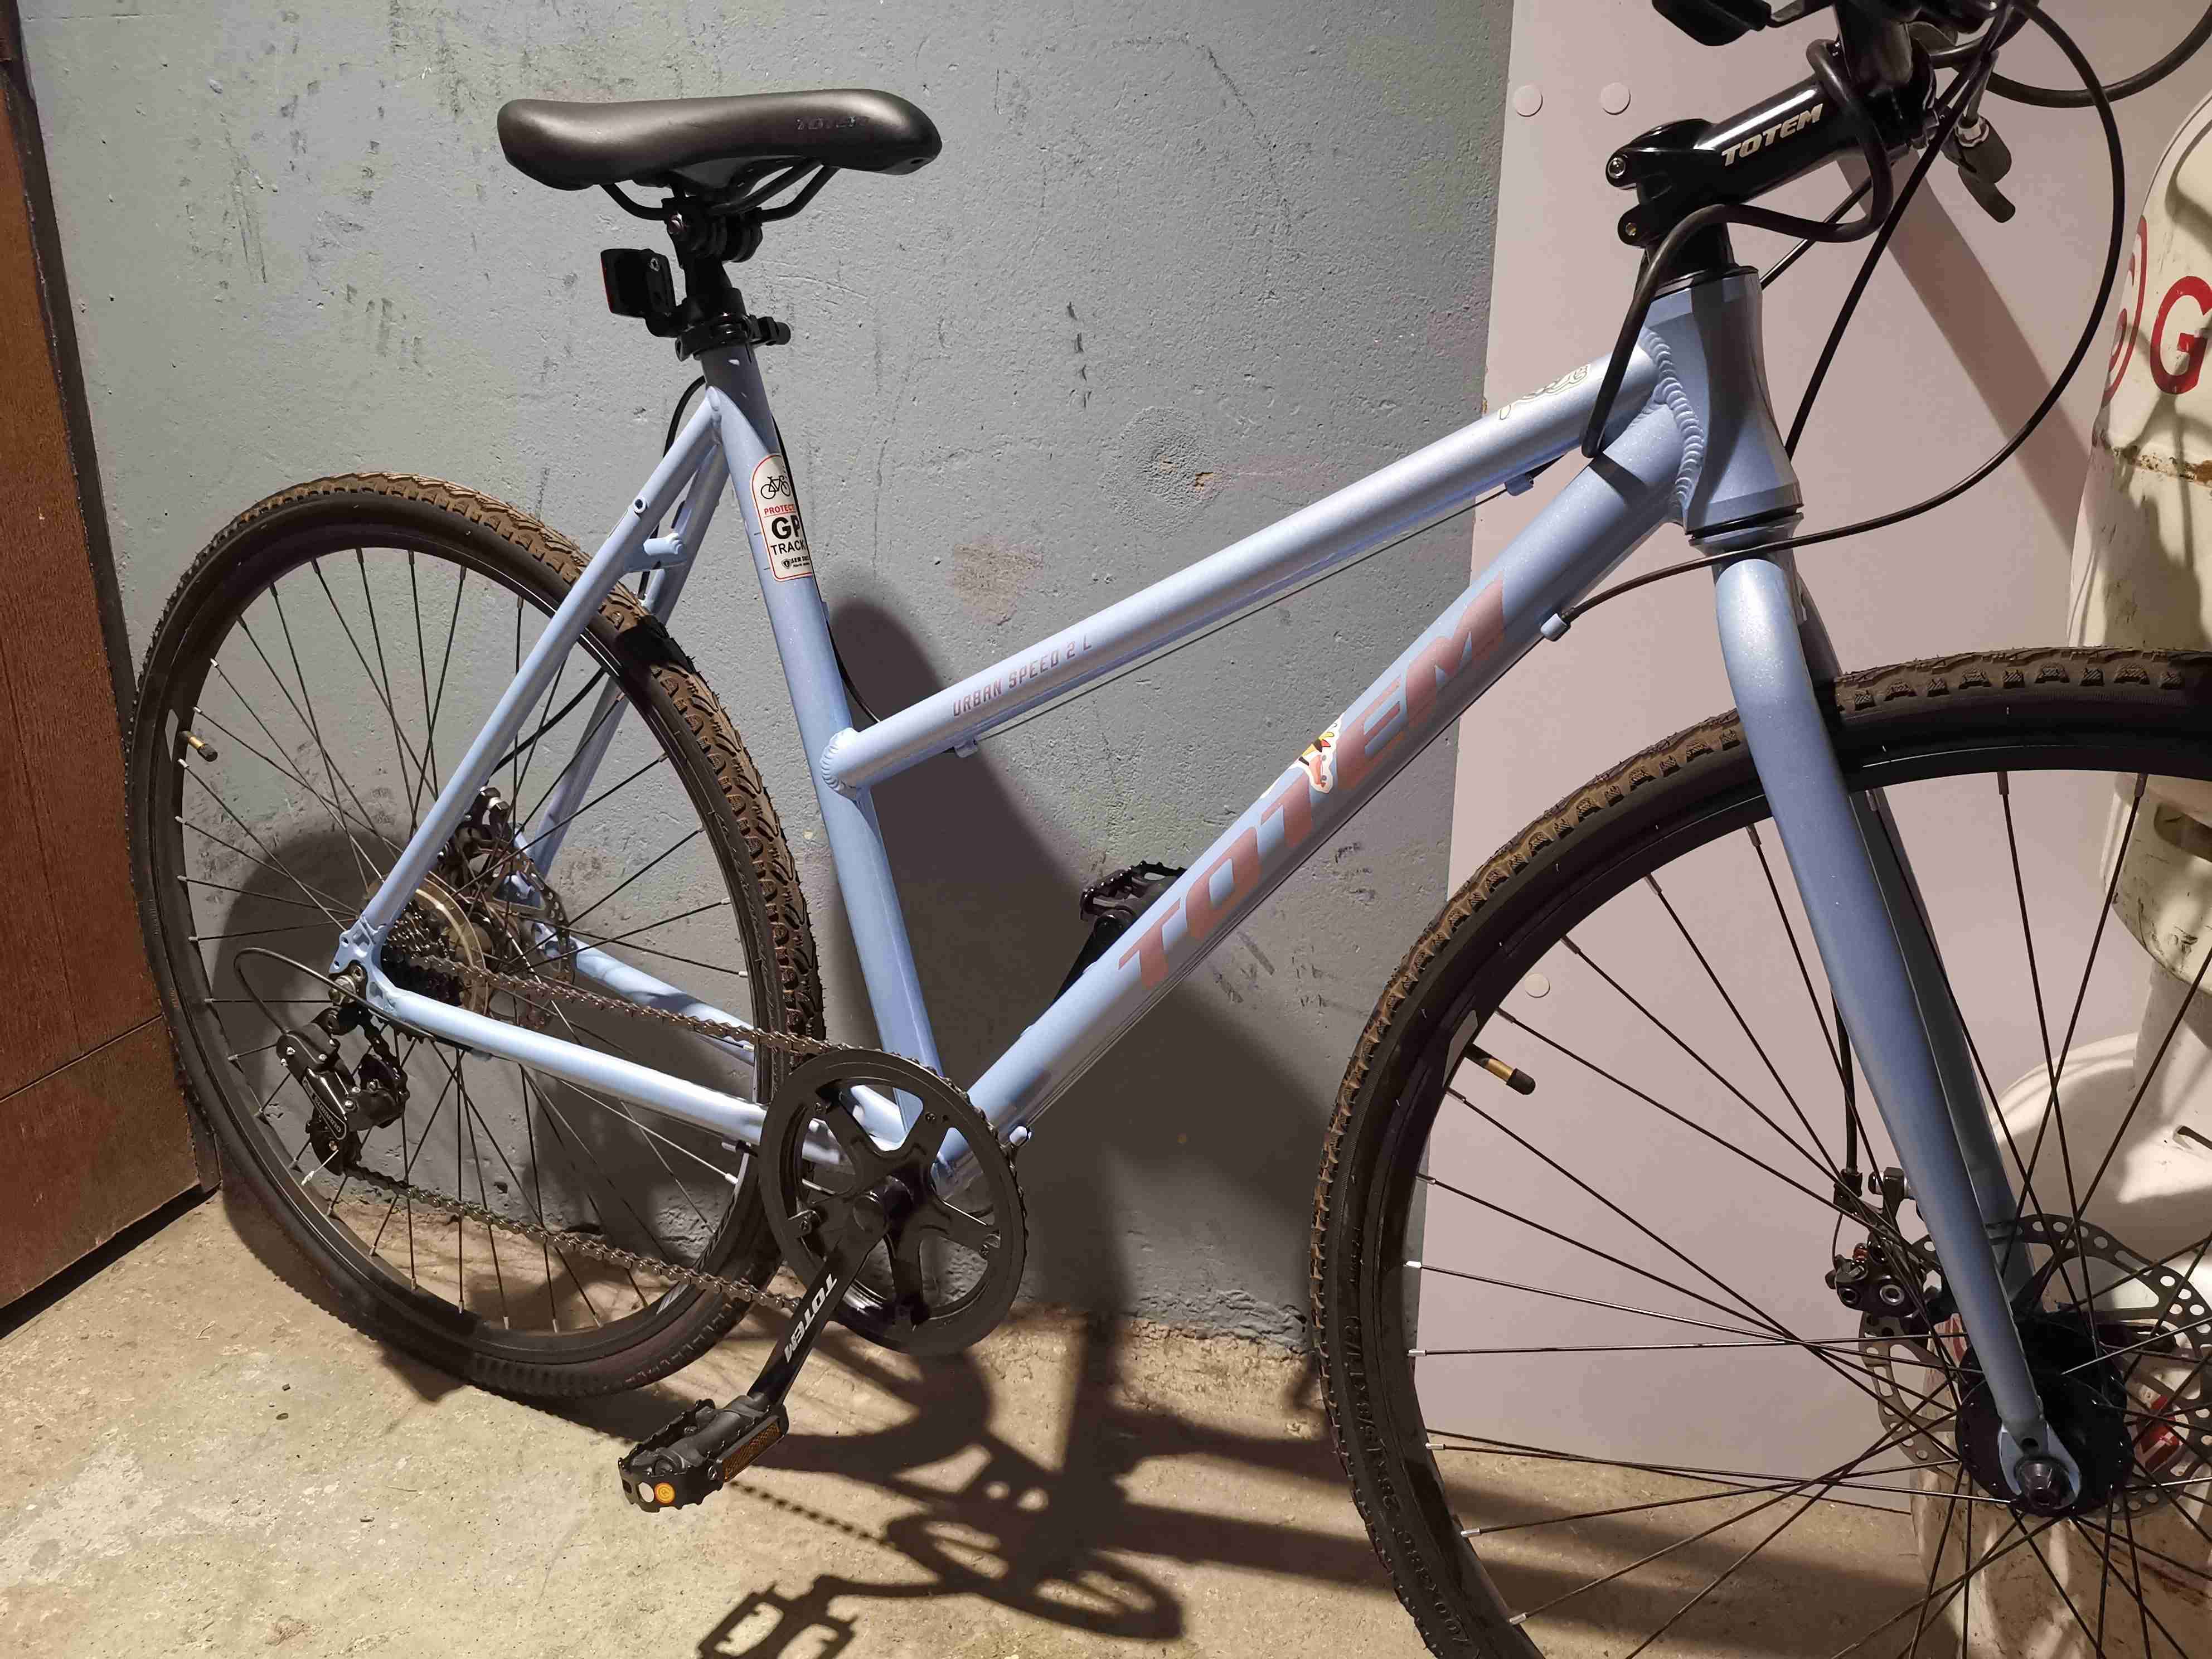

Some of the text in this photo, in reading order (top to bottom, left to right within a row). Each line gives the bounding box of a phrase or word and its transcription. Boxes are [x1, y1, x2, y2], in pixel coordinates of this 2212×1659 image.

[1721, 103, 1823, 166] TOTEM
[2150, 275, 2212, 395] G
[953, 634, 1092, 717] URBAN SPEED 2 L
[1118, 579, 1504, 991] TOTEM
[784, 1273, 837, 1363] TOTEM
